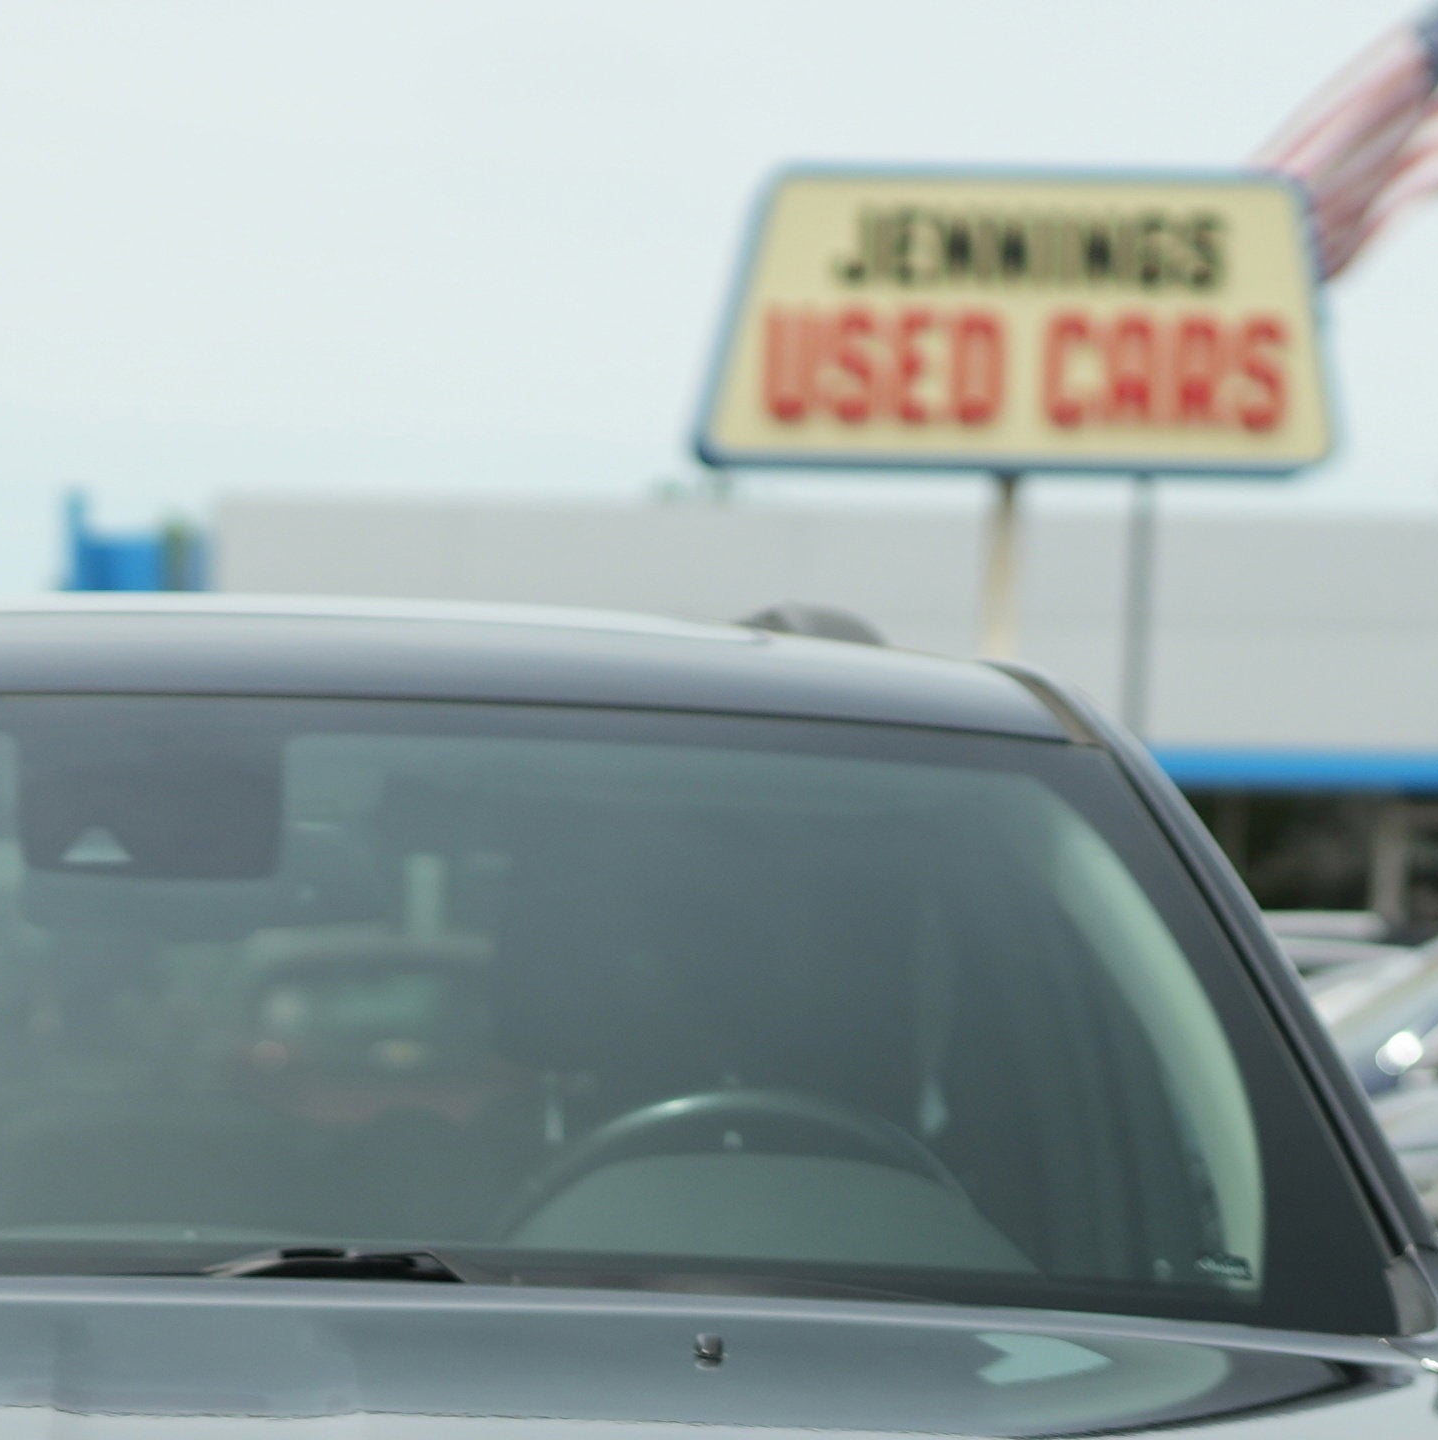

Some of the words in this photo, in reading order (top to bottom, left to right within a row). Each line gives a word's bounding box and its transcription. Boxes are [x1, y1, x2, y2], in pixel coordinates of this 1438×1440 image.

[835, 206, 1228, 290] JENNINGS
[762, 308, 1005, 426] USED
[1043, 310, 1289, 433] CARS
